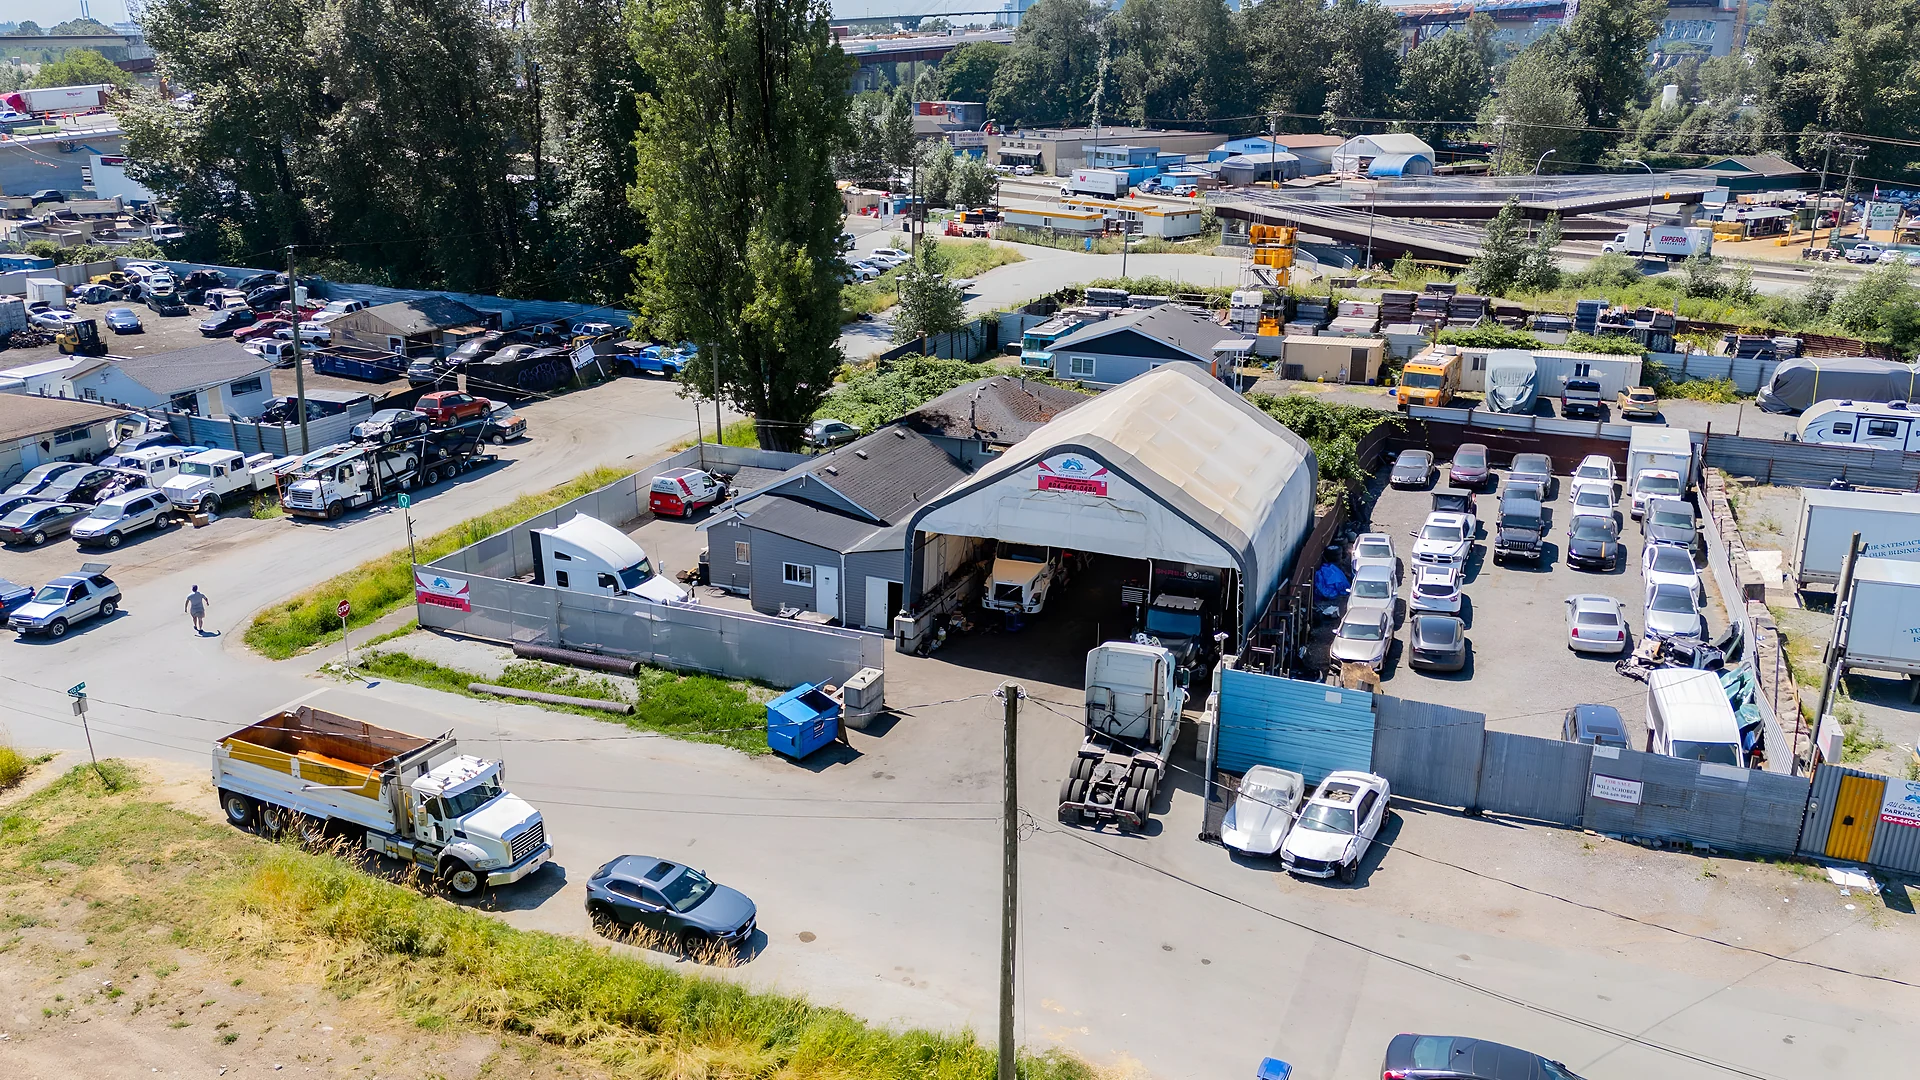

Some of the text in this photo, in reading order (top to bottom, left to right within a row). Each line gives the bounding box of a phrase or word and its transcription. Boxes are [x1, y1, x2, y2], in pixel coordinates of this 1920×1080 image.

[1660, 235, 1687, 244] EMPEROR
[338, 603, 350, 615] STOP
[1884, 807, 1916, 818] PARKING
